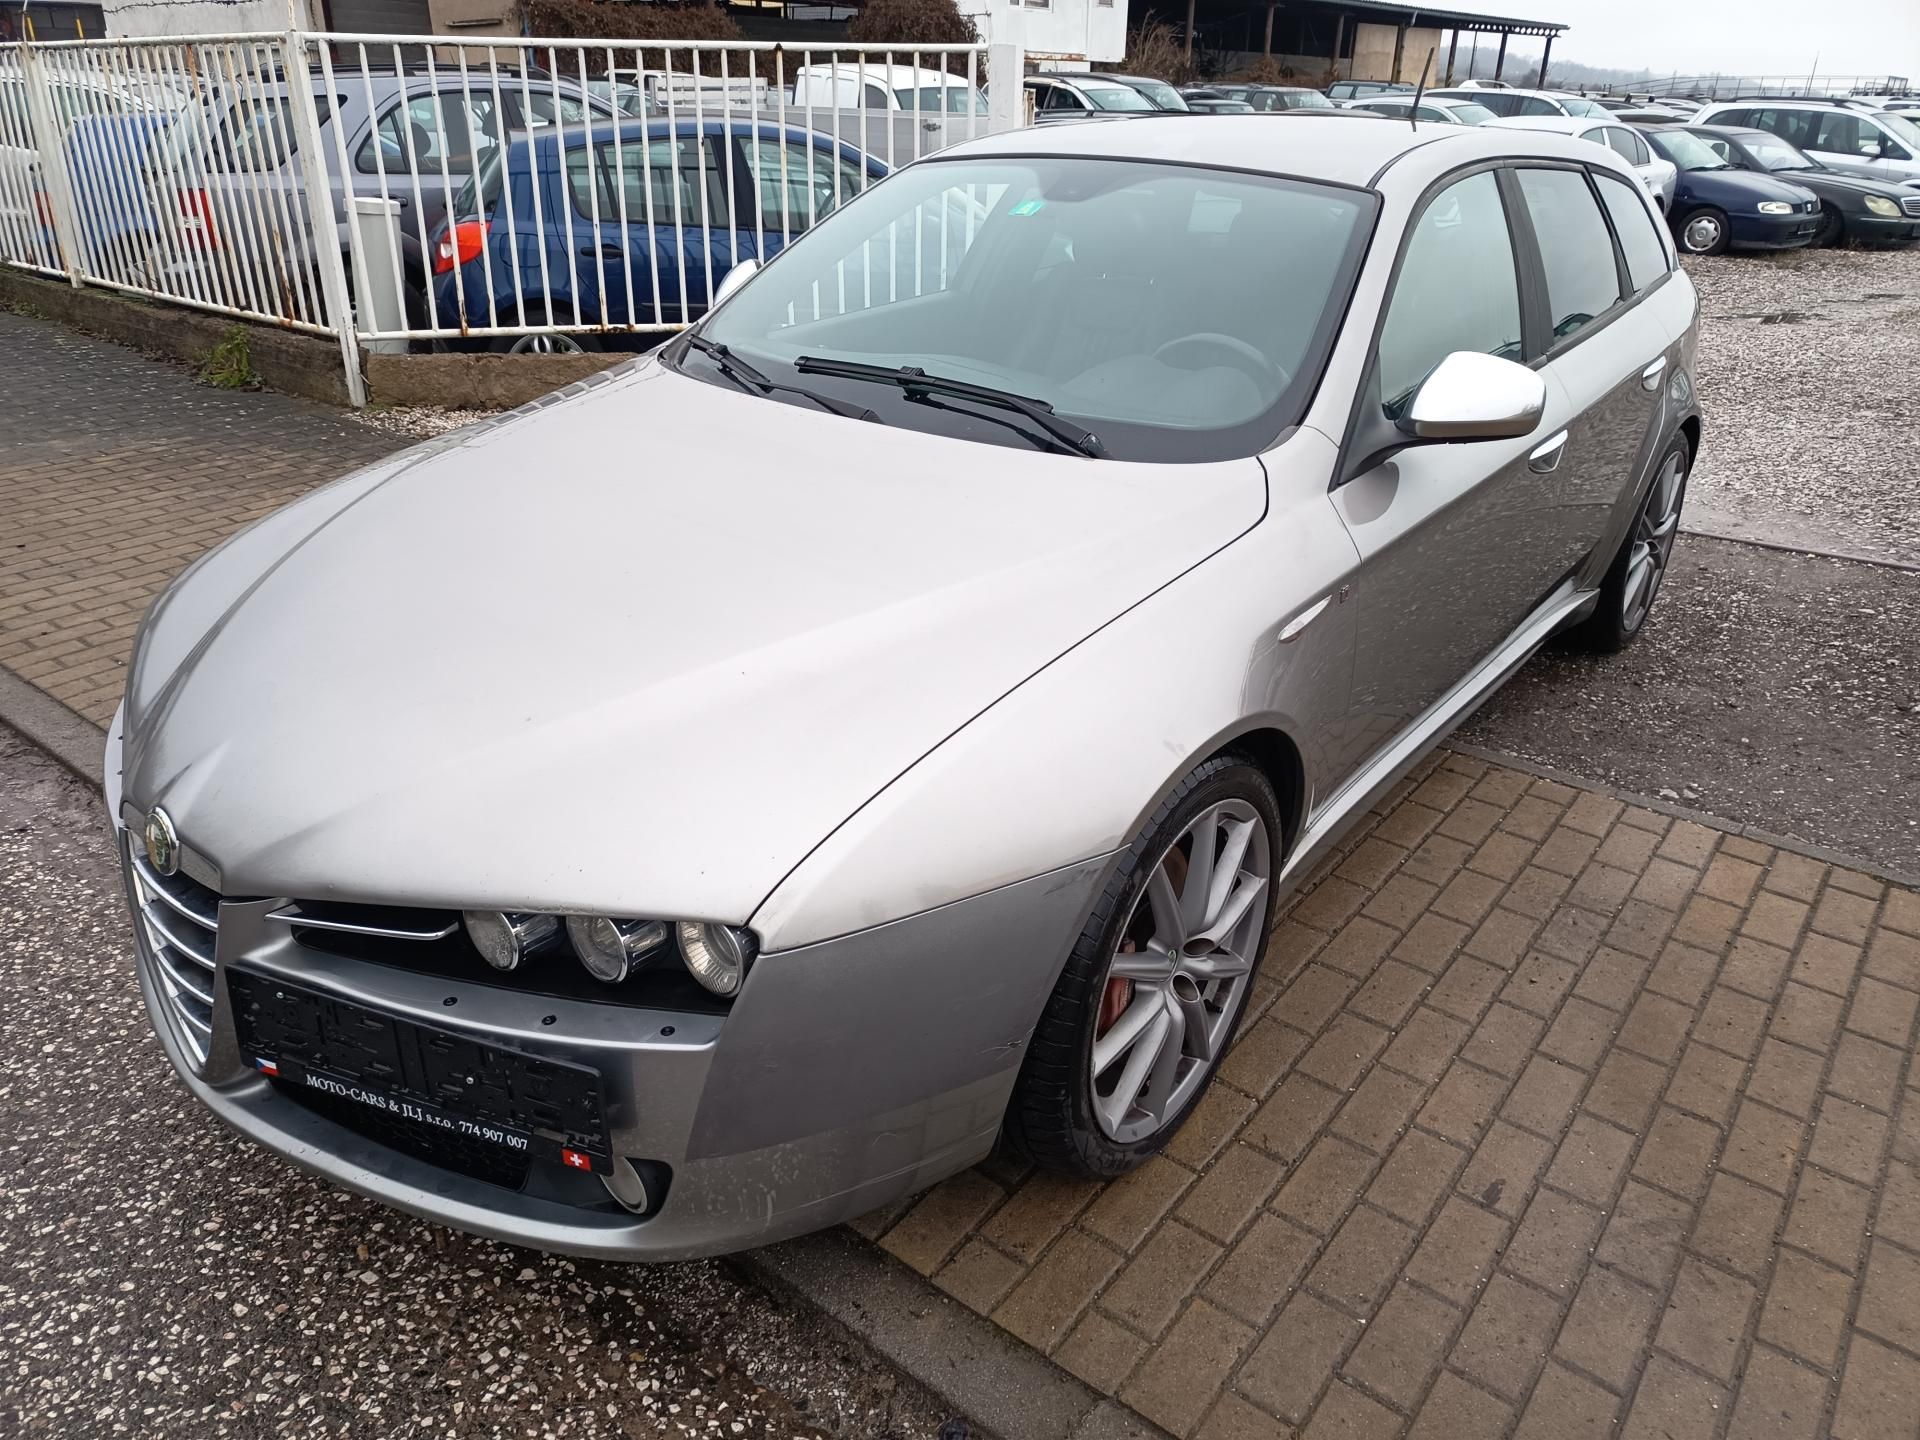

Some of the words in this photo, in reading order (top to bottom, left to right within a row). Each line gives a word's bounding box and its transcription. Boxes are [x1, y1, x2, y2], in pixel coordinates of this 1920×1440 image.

[306, 1074, 386, 1108] MOTO-CARS
[389, 1100, 399, 1112] &
[401, 1103, 422, 1121] JLJ
[426, 1114, 455, 1129] s.r.o.
[459, 1121, 480, 1136] 774
[482, 1127, 503, 1143] 907
[507, 1135, 527, 1150] 007
